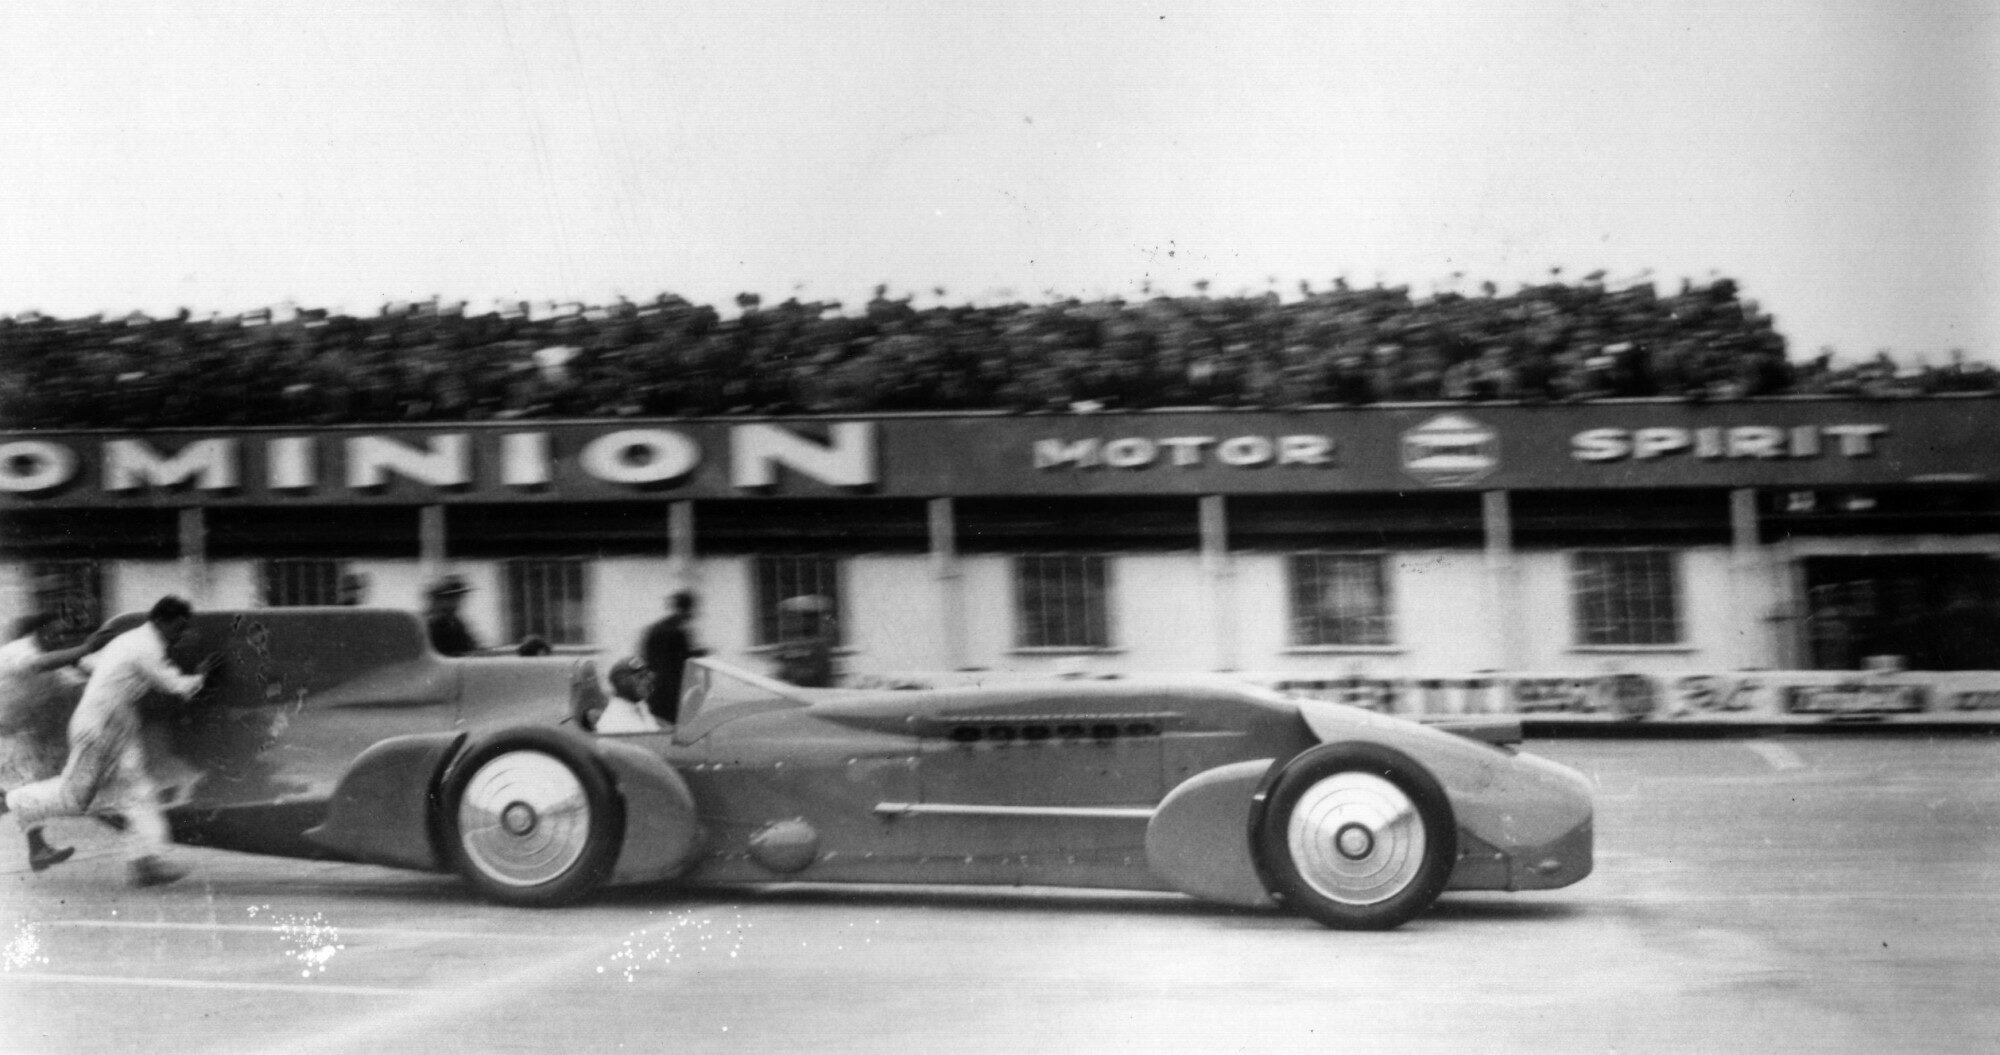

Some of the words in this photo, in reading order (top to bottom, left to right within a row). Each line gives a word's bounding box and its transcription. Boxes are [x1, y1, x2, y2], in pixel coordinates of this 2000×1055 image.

[0, 421, 880, 492] OMINION
[1032, 434, 1336, 469] MOTOR
[1570, 424, 1890, 461] SPIRIT
